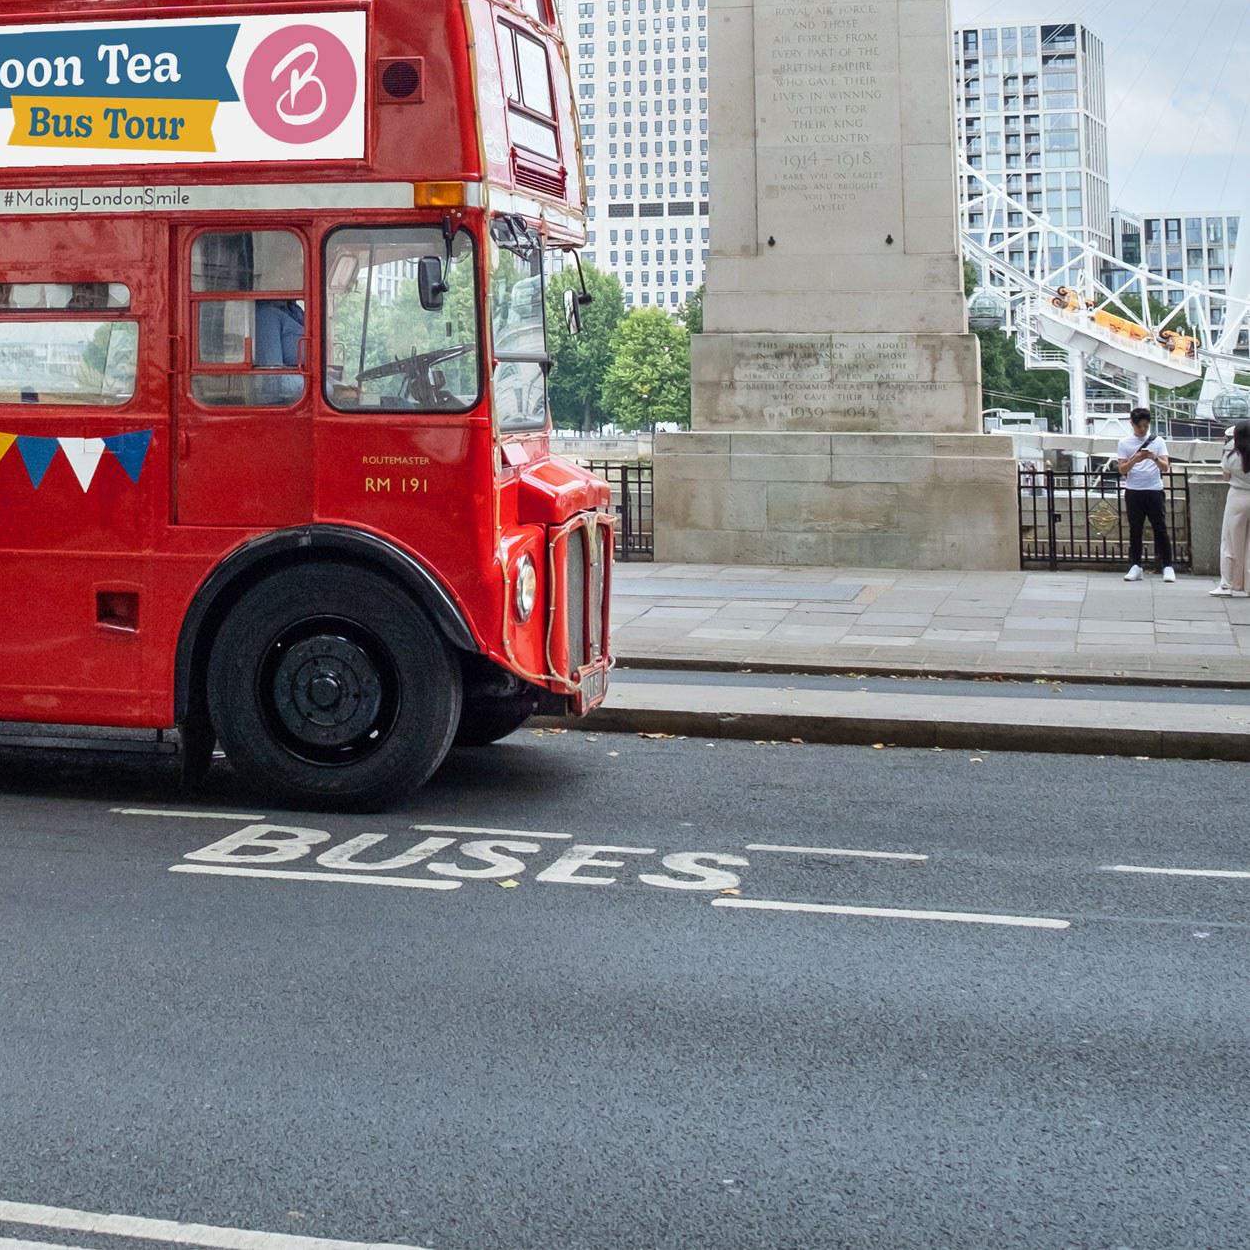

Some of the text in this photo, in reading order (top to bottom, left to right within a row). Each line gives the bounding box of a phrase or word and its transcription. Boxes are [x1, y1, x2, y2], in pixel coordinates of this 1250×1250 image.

[775, 6, 811, 16] ROYAL
[792, 19, 858, 30] AND THOSE
[798, 34, 839, 44] FORCES
[846, 32, 878, 42] FROM
[772, 46, 879, 59] EVERY PART OF THE
[96, 43, 182, 85] Tea
[780, 61, 872, 73] BRITISH EMPIRE
[808, 77, 837, 87] GAVE
[843, 76, 877, 86] THEIR
[773, 90, 882, 102] LIVES IN WINNING
[787, 104, 868, 115] VICTORY FOR
[27, 106, 185, 143] Bus Tour
[791, 118, 863, 129] THEIR KING
[783, 133, 871, 143] AND COUNTRY
[833, 172, 847, 180] ON
[4, 186, 190, 212] #MakingLondonSmile
[858, 342, 870, 350] IS
[877, 342, 908, 350] ADDED
[838, 393, 863, 401] THEIR
[871, 393, 897, 401] LIVES
[362, 455, 430, 465] ROUTEMASTER
[365, 477, 428, 493] RM 191
[182, 823, 750, 891] BUSES
